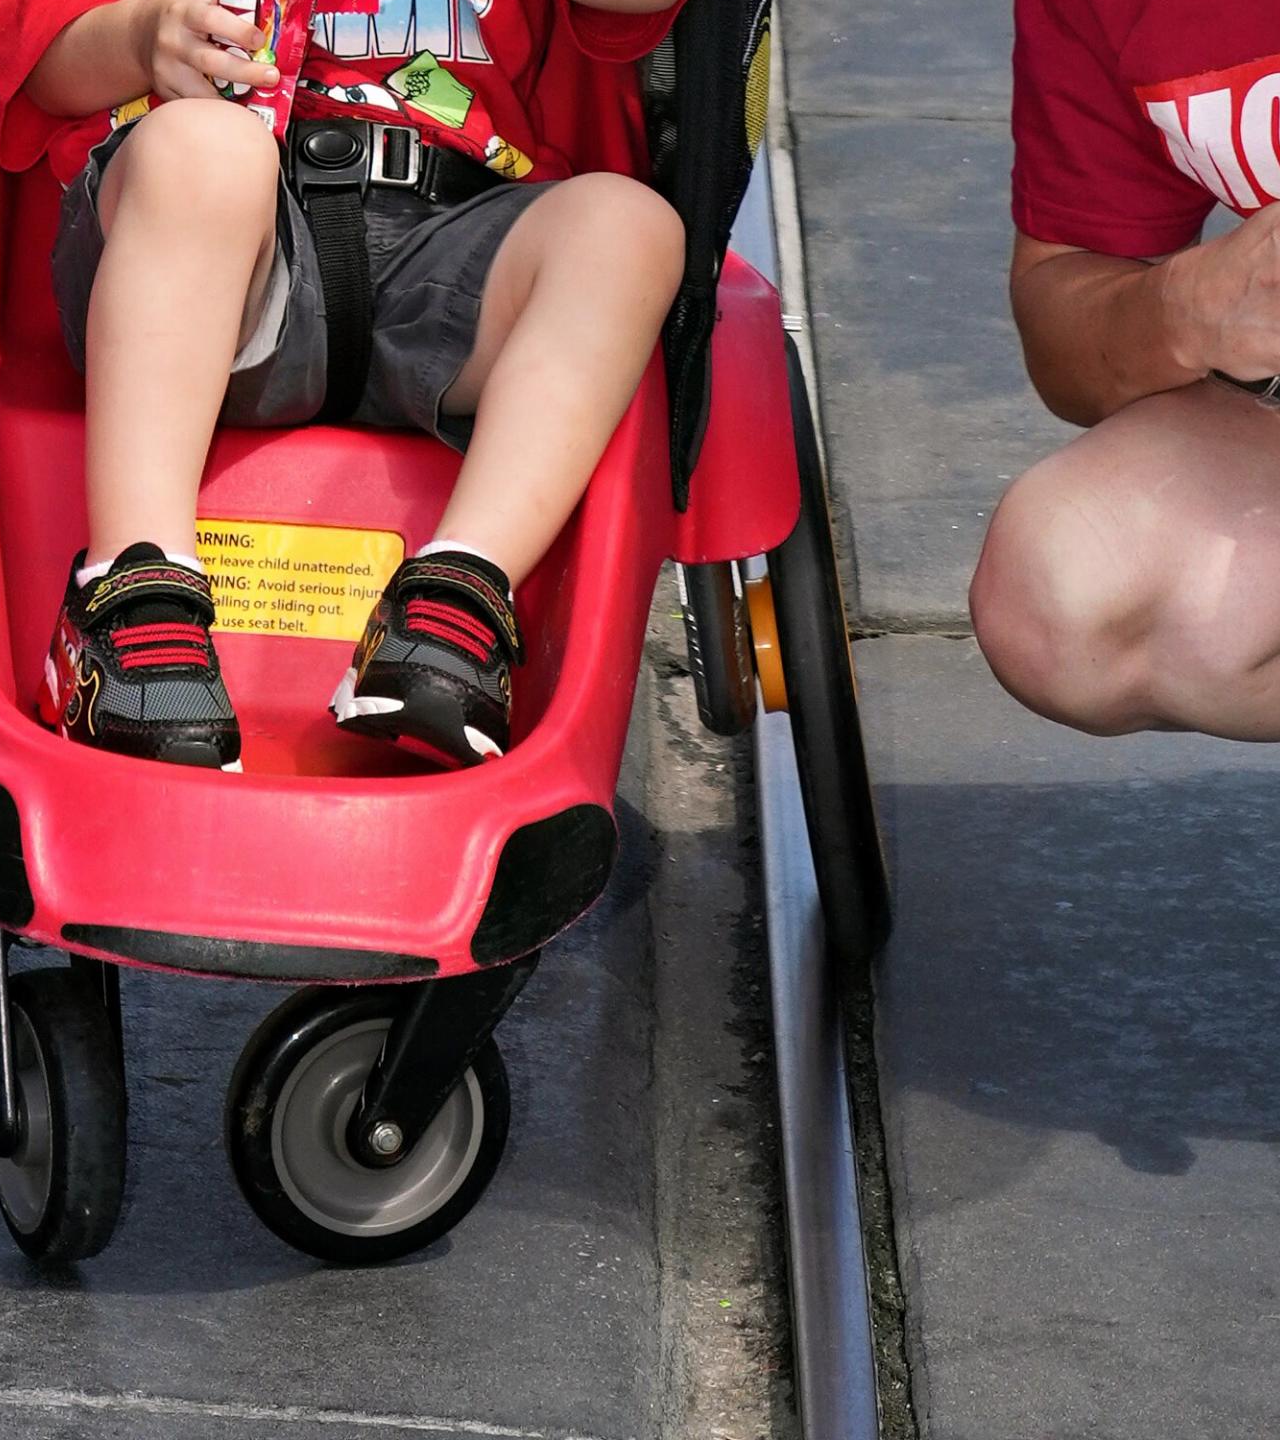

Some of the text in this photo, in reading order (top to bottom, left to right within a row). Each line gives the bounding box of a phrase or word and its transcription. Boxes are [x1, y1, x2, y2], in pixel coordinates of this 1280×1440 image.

[196, 531, 255, 549] ARNING:
[220, 554, 255, 568] leave
[257, 557, 290, 571] child
[293, 561, 374, 578] unattended.
[209, 574, 251, 590] NING:
[257, 578, 296, 593] Avoid
[298, 583, 346, 597] serious
[253, 599, 267, 609] or
[270, 598, 315, 617] sliding
[318, 604, 345, 617] out.
[222, 617, 245, 628] use
[248, 618, 276, 630] seat
[278, 620, 308, 633] belt.
